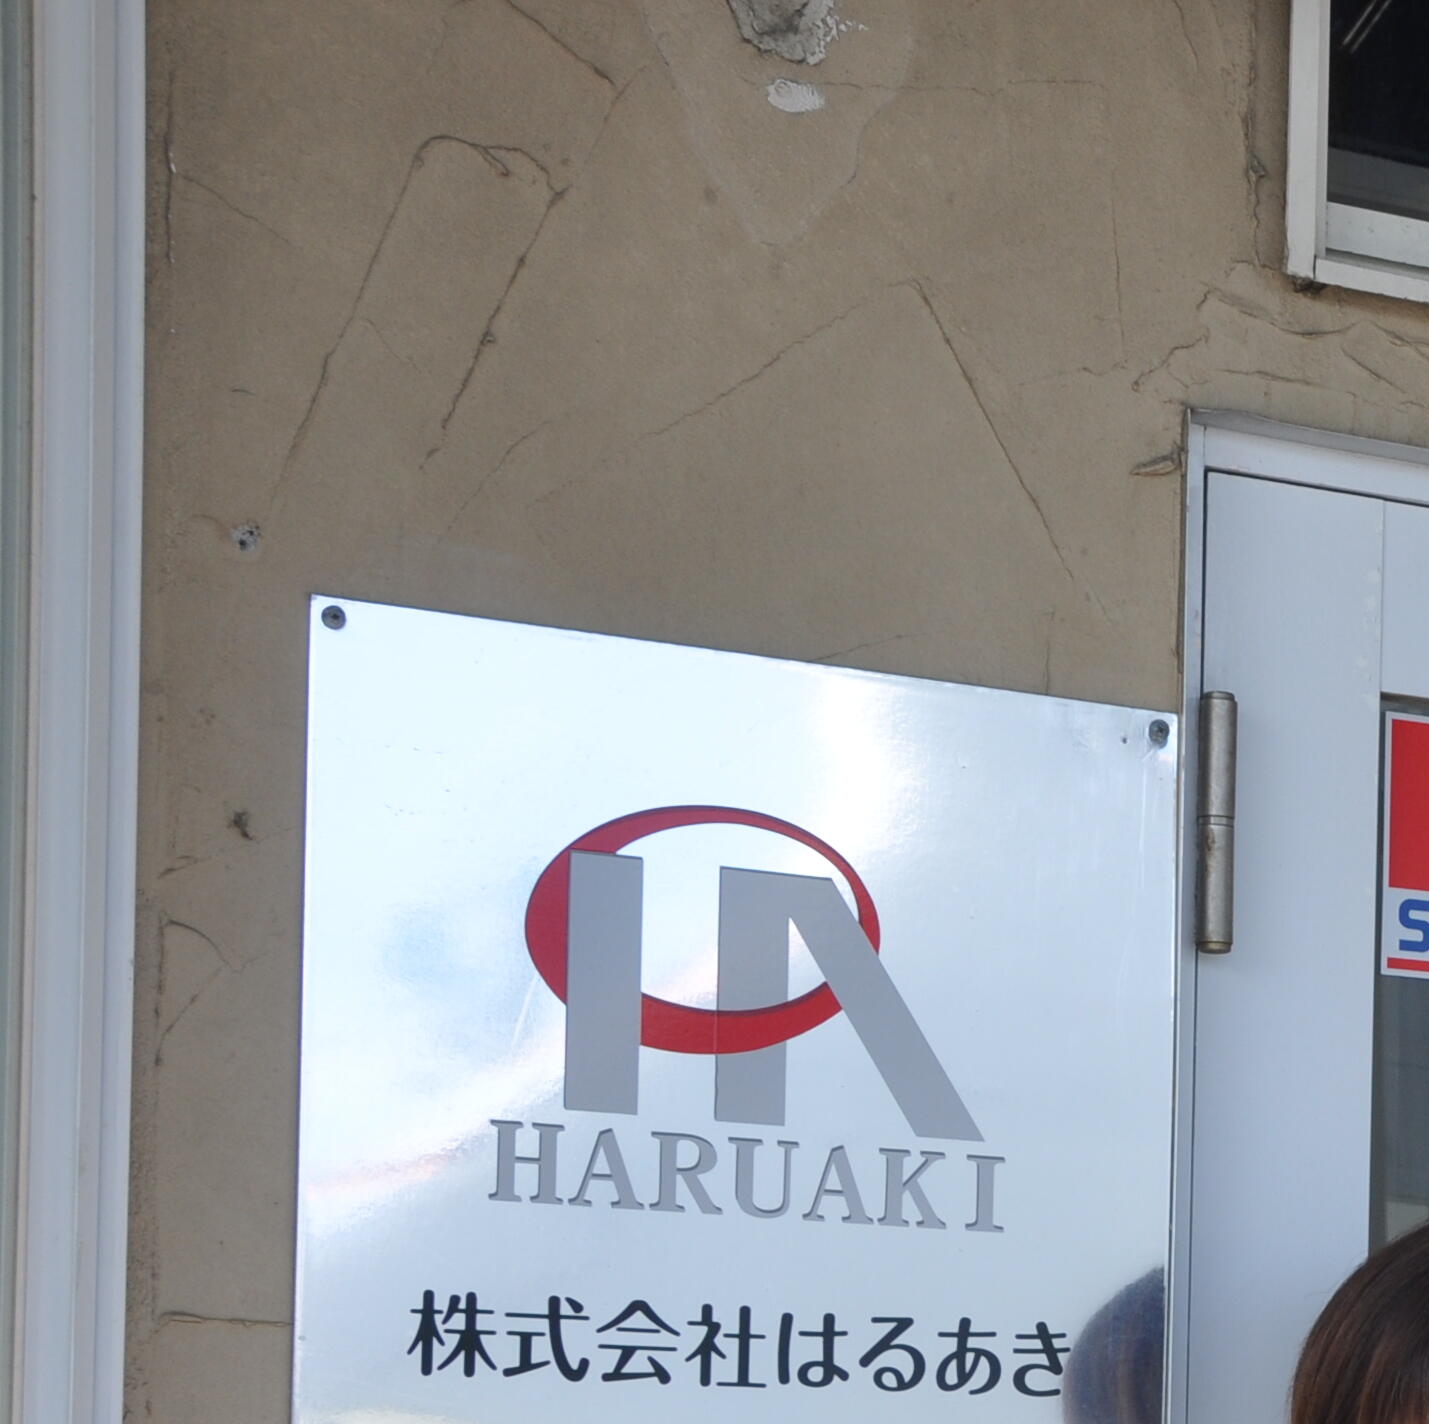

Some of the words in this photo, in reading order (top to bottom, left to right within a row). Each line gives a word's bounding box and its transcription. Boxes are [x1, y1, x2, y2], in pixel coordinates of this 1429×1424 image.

[488, 1118, 1006, 1233] HARUAKI
[406, 1289, 1073, 1397] 株式会社はるあき
